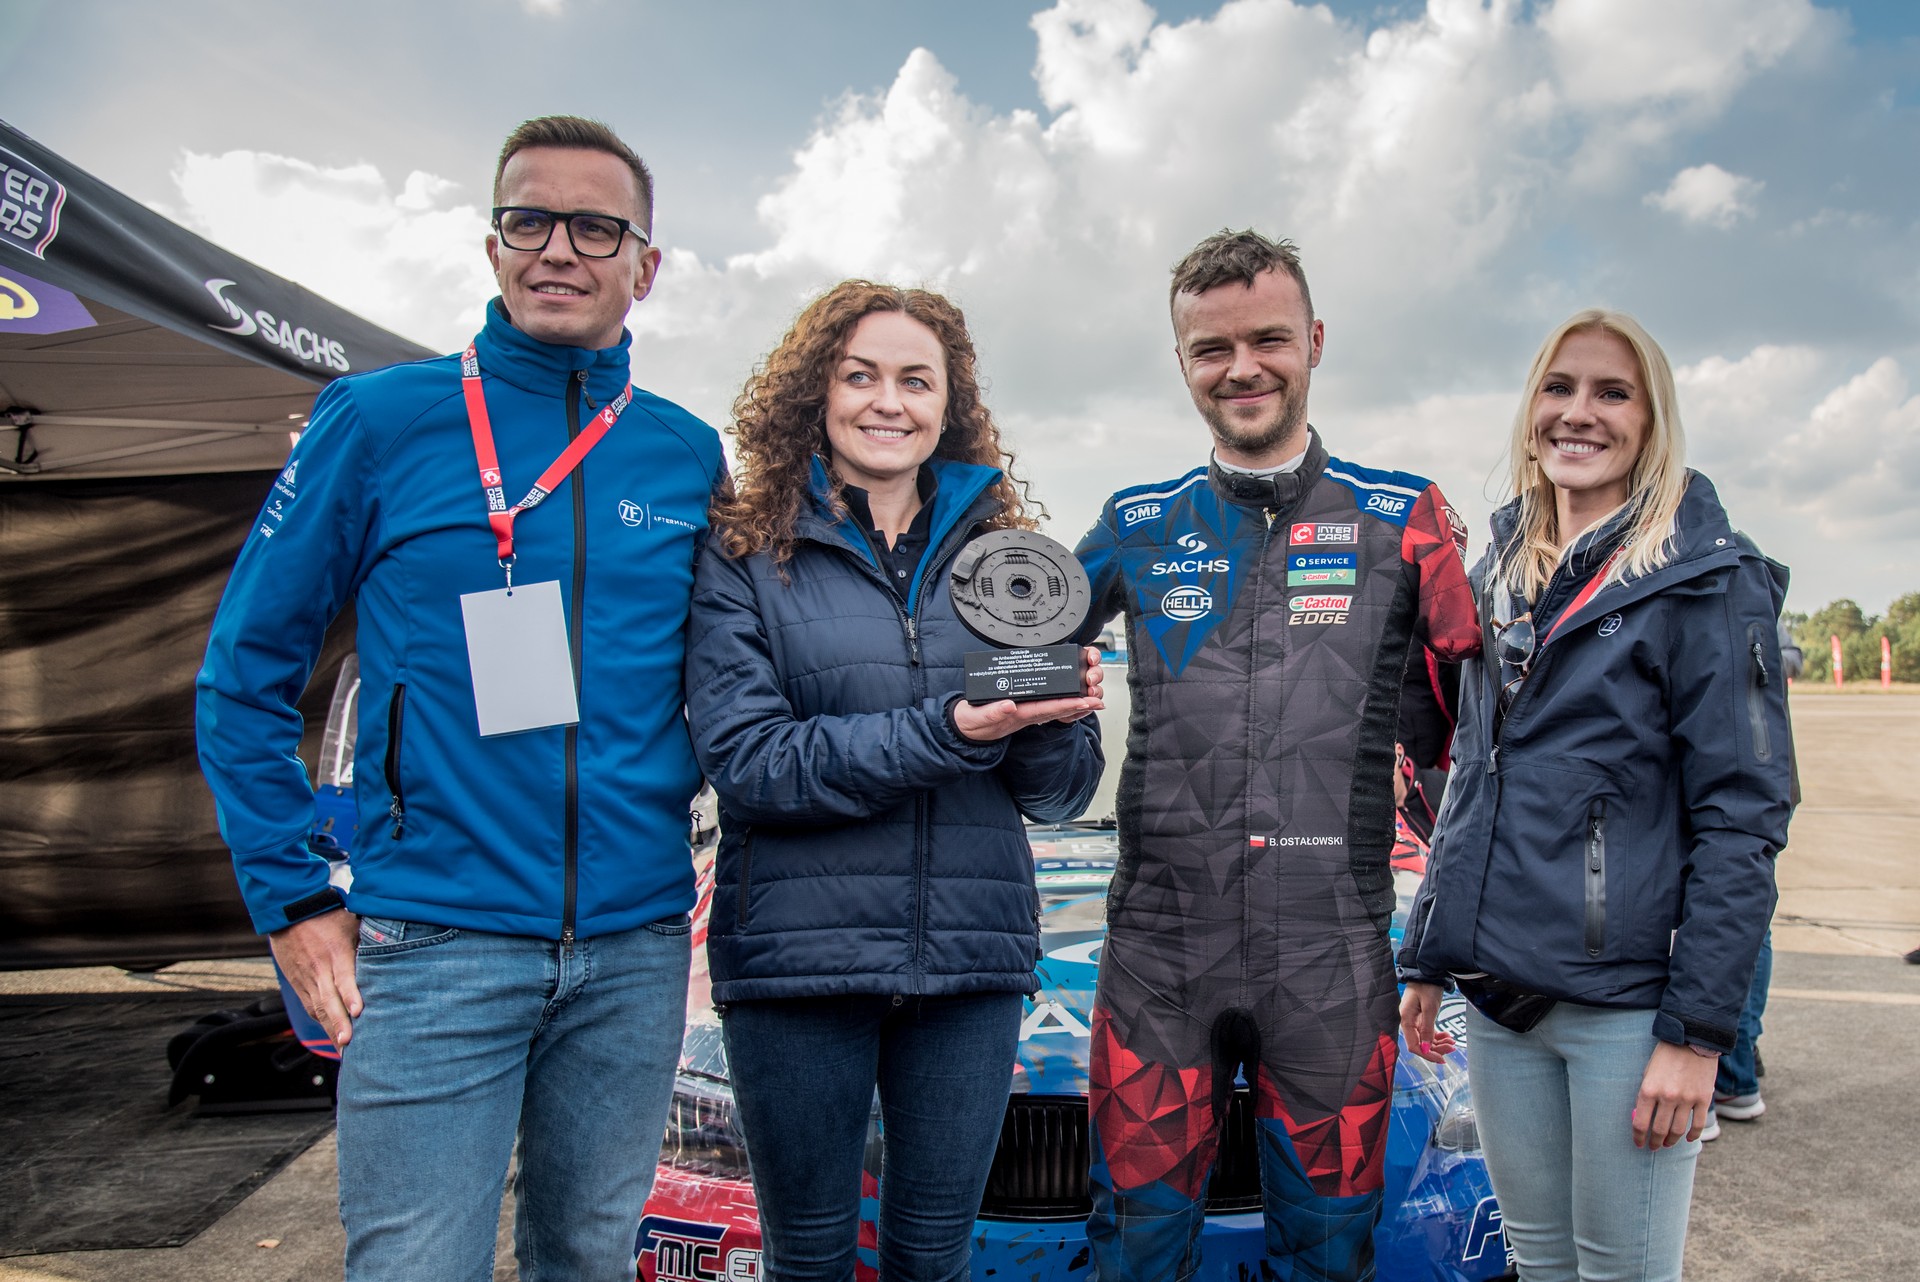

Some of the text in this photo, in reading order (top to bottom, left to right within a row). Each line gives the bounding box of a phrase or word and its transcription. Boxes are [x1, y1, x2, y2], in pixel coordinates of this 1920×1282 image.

[0, 198, 43, 240] RS
[255, 310, 350, 372] SACHS
[486, 488, 499, 511] CARS
[494, 486, 507, 510] INTER
[1366, 496, 1406, 512] OMP
[618, 501, 697, 531] ZF AFTERMARKET
[1124, 506, 1161, 522] OMP
[1317, 526, 1352, 534] INTER
[1317, 533, 1351, 542] CARS
[1151, 559, 1230, 576] SACHS
[1308, 557, 1349, 566] SERVICE
[1165, 596, 1213, 610] HELLA
[1304, 596, 1348, 609] Castrol
[1288, 612, 1350, 626] EDGE
[1269, 836, 1343, 847] B. OSTAŁOWSKI
